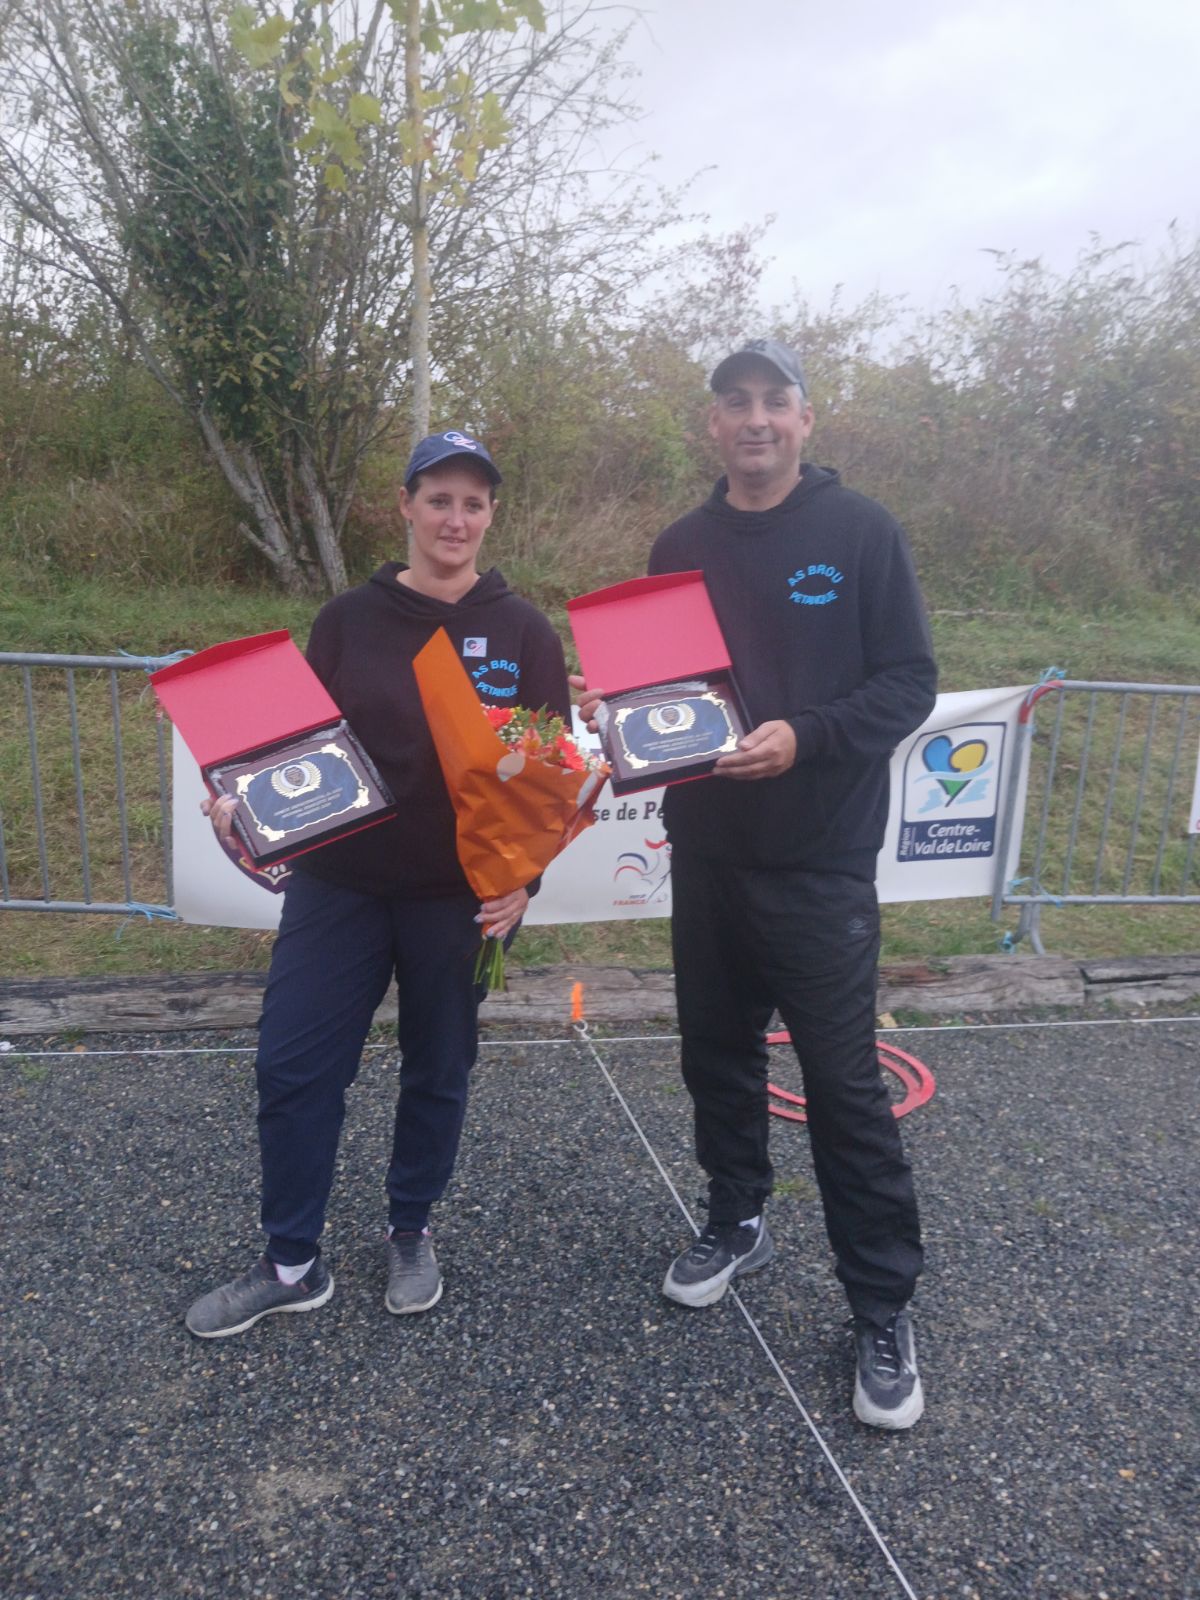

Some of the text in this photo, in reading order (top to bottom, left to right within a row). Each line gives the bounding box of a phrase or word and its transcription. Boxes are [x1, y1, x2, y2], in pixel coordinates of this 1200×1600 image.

[788, 564, 844, 587] AS BROU
[472, 665, 489, 679] AS
[616, 802, 637, 821] de
[927, 823, 981, 838] Centre-
[914, 838, 992, 855] Val de Loire
